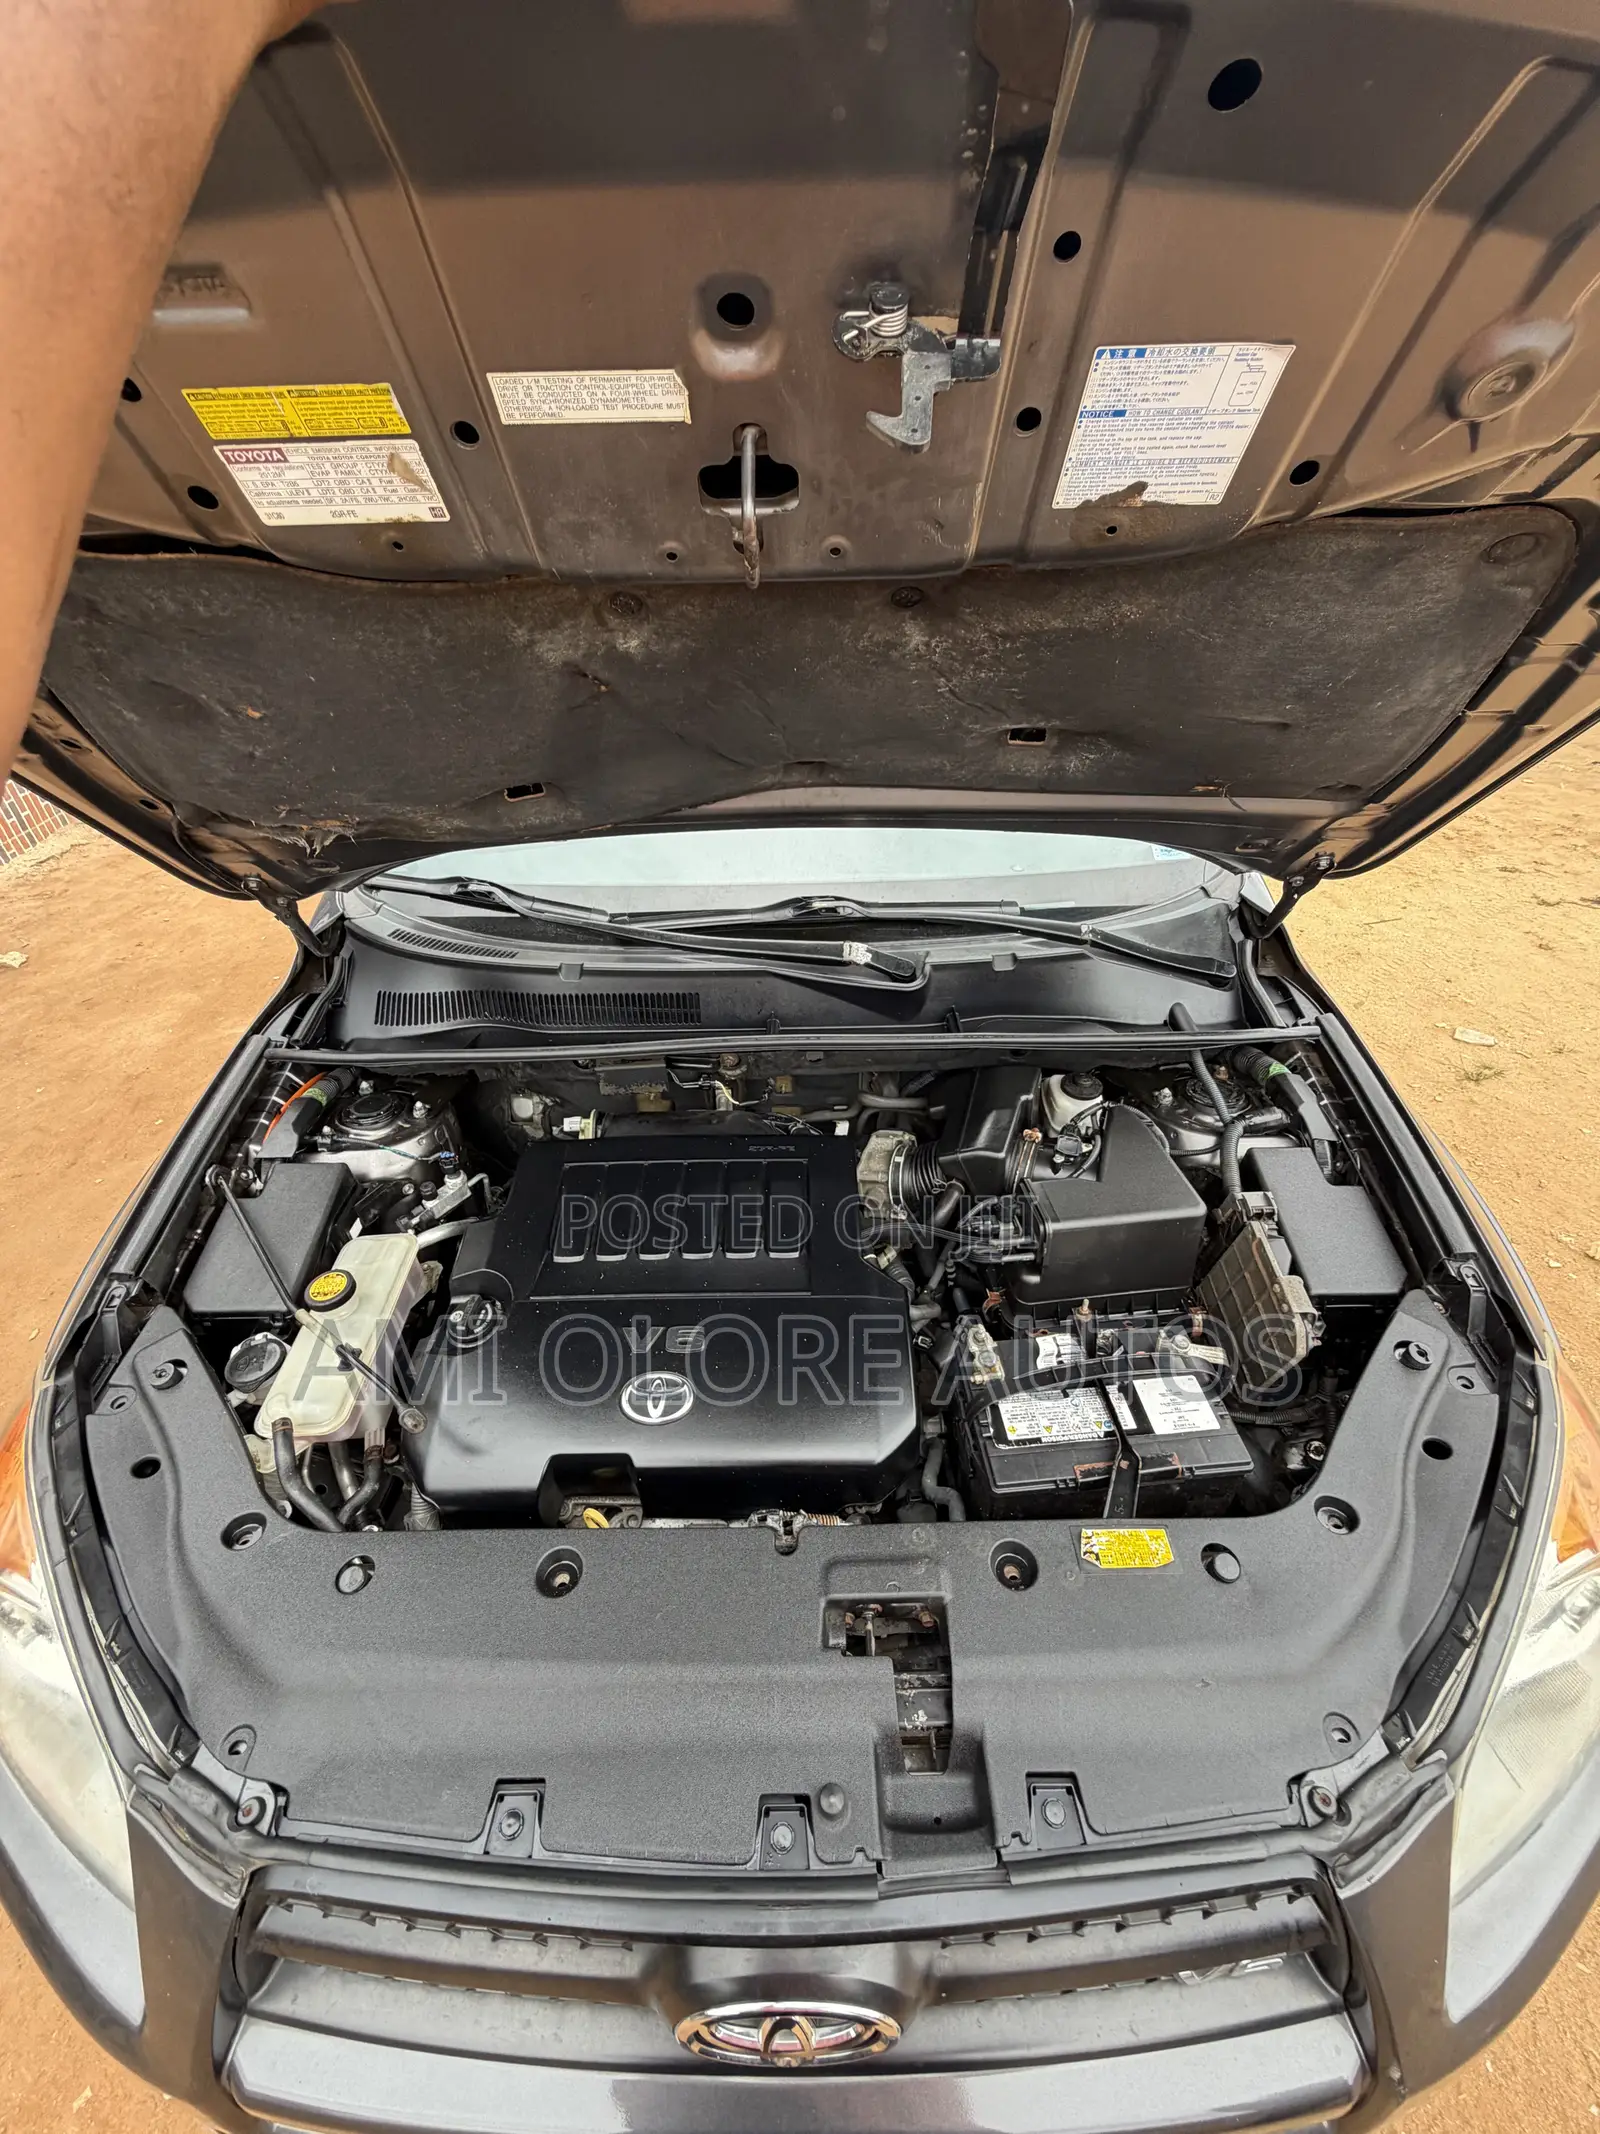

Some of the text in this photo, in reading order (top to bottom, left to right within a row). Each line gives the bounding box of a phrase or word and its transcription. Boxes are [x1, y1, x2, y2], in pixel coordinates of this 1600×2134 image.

[495, 378, 524, 386] LOADED
[589, 376, 632, 384] PERMANENT
[536, 384, 571, 392] TRACTION
[573, 383, 646, 391] CONTROL-EQUIPPED
[610, 389, 659, 397] FOUR-WHEEL
[531, 398, 587, 406] SYNCHRONIZED
[556, 404, 600, 412] NON-LOADED
[666, 402, 685, 410] MUST
[519, 411, 566, 419] PERFORMED.
[1081, 410, 1114, 418] NOTICE
[343, 446, 373, 454] CONTROL
[224, 450, 284, 462] TOYOTA
[310, 469, 331, 477] EVAP
[622, 1325, 706, 1354] V6
